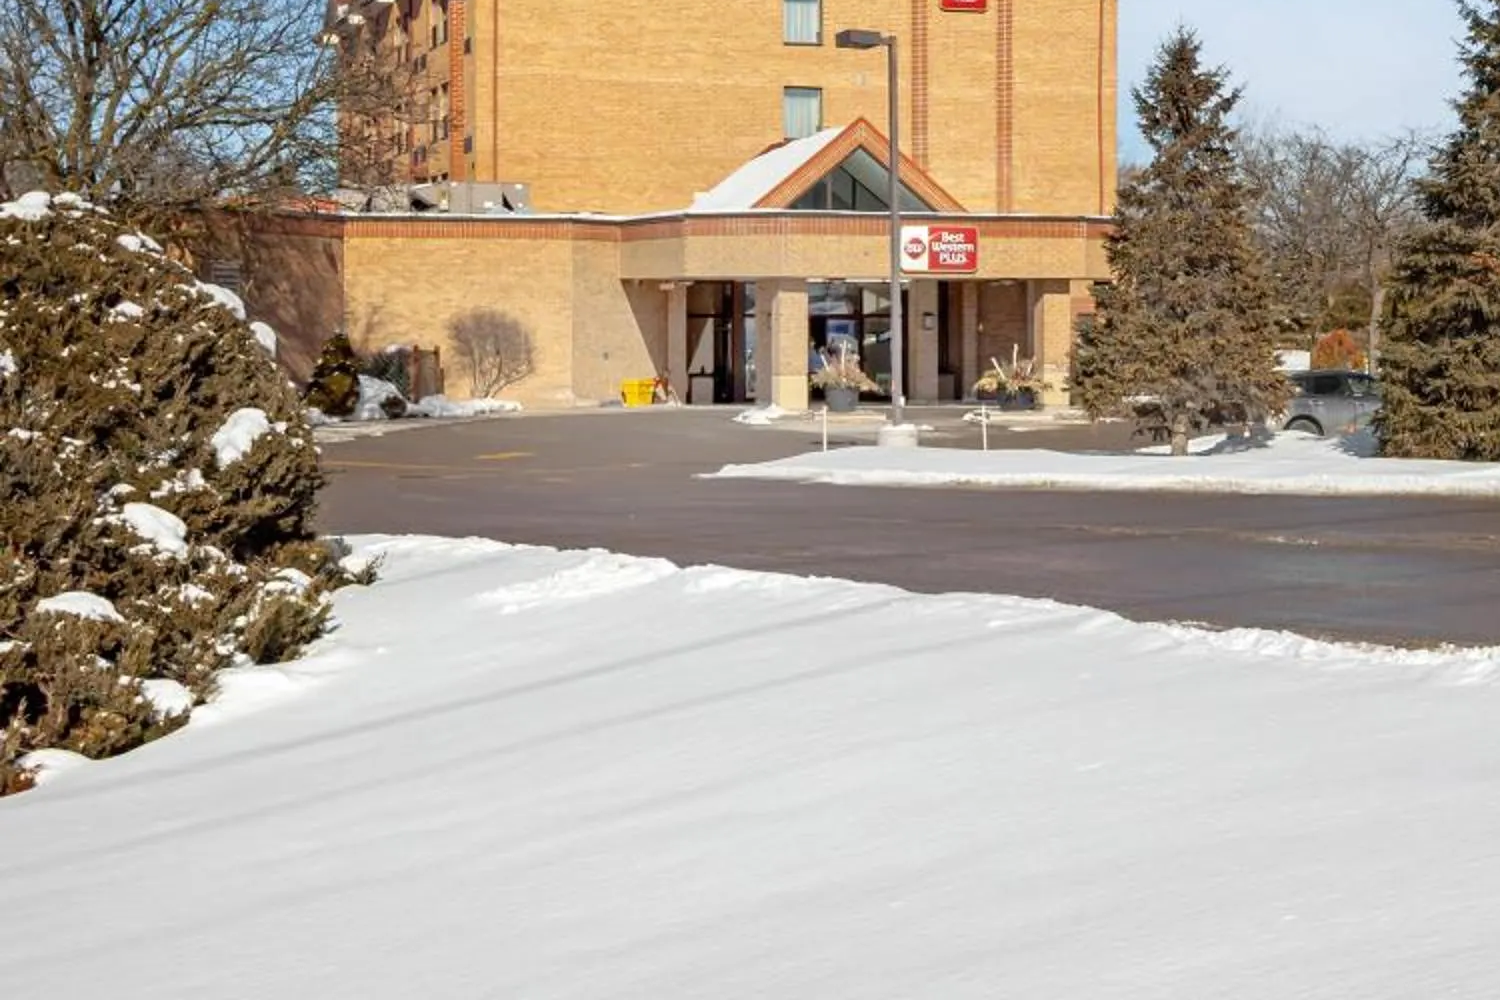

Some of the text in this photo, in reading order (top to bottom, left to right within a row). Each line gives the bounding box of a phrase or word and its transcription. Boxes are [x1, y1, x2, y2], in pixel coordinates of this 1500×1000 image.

[941, 231, 965, 243] Best
[931, 242, 975, 253] Western
[940, 252, 967, 263] PLUS
